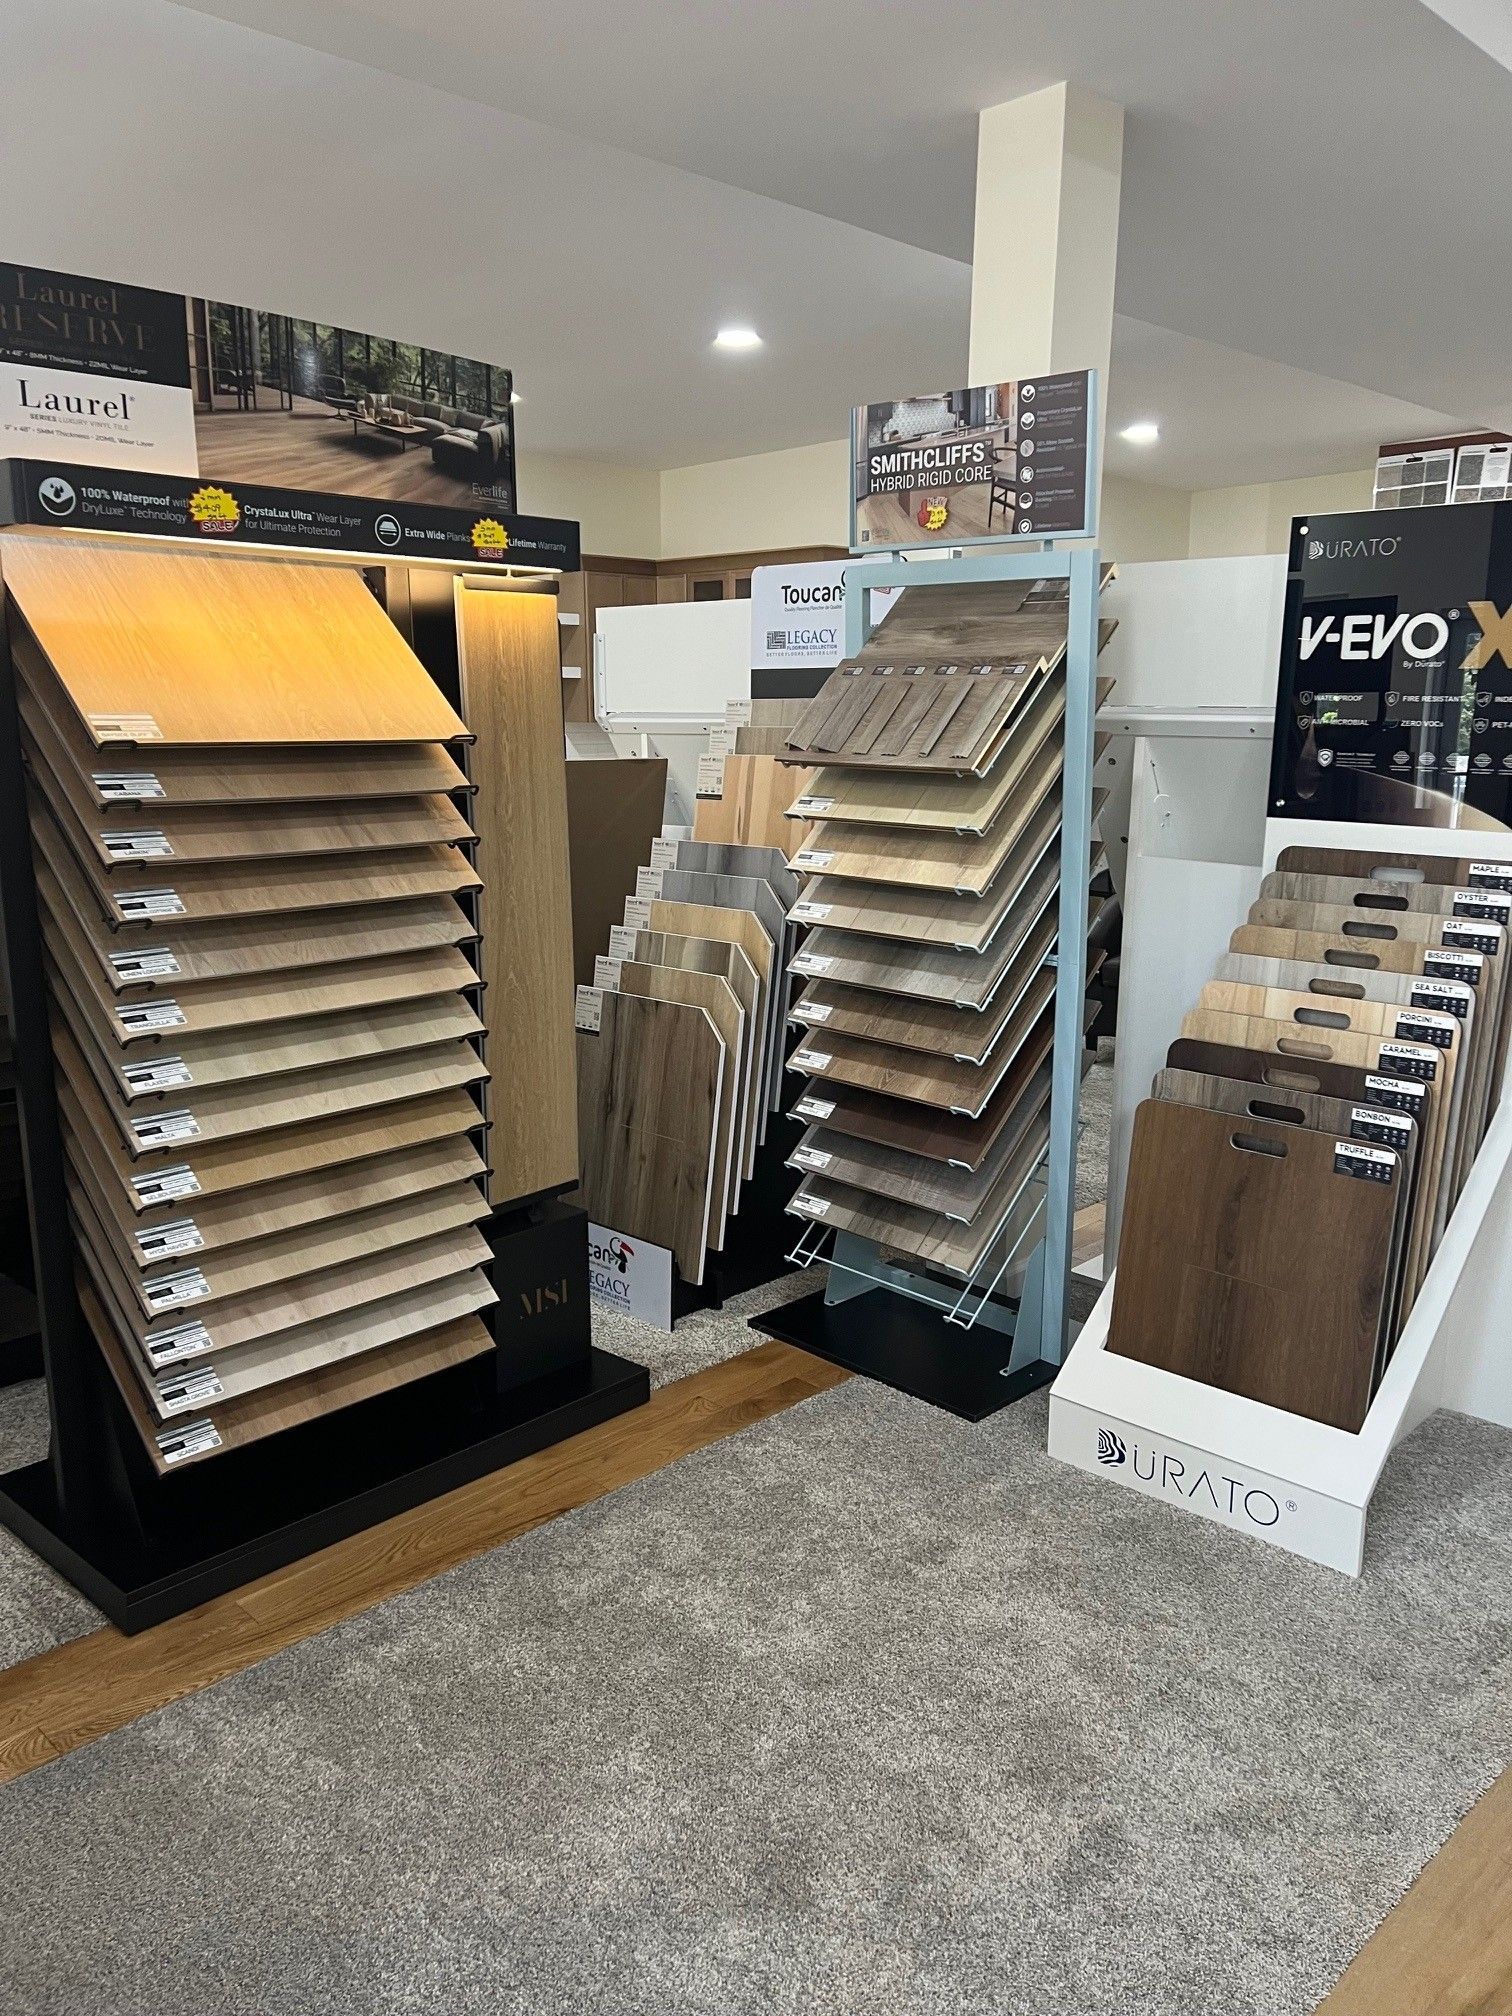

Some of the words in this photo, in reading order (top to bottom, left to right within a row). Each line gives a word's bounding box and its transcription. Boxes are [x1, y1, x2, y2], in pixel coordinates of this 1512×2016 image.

[17, 272, 118, 314] Laurel
[870, 474, 915, 492] HYBRID
[918, 469, 951, 488] RIGID
[955, 465, 992, 483] CORE
[81, 487, 111, 500] 100%
[112, 489, 170, 507] Waterproof
[472, 482, 508, 499] Everlife
[129, 506, 187, 525] Technology
[244, 504, 290, 519] CrystaLux
[317, 513, 336, 524] Wear
[338, 514, 361, 526] Layer
[202, 520, 235, 532] SALE
[244, 517, 258, 529] for
[259, 521, 297, 533] Ultimate
[298, 525, 341, 537] Protection
[404, 528, 424, 539] Extra
[425, 529, 445, 540] Wide
[446, 530, 471, 543] Planks
[508, 537, 537, 549] Lifetime
[537, 540, 567, 553] Warranty
[478, 547, 504, 558] SALE
[780, 585, 843, 605] Toucan
[787, 629, 838, 645] LEGACY
[1402, 660, 1413, 669] By
[1311, 718, 1370, 726] ANMICROBIAL
[1400, 719, 1421, 727] ZERO
[1472, 865, 1500, 873] MAPLE
[1457, 893, 1488, 902] OYSTER
[1446, 922, 1463, 930] OAT
[1427, 951, 1464, 962] BISCOTTI
[1414, 983, 1430, 991] SEA
[1432, 985, 1453, 993] SALT
[1400, 1012, 1433, 1023] PORCINI
[1382, 1044, 1422, 1057] CARAMEL
[1369, 1077, 1400, 1089] MOCHA
[1355, 1110, 1390, 1123] BONBON
[1339, 1143, 1374, 1157] TRUFFLE
